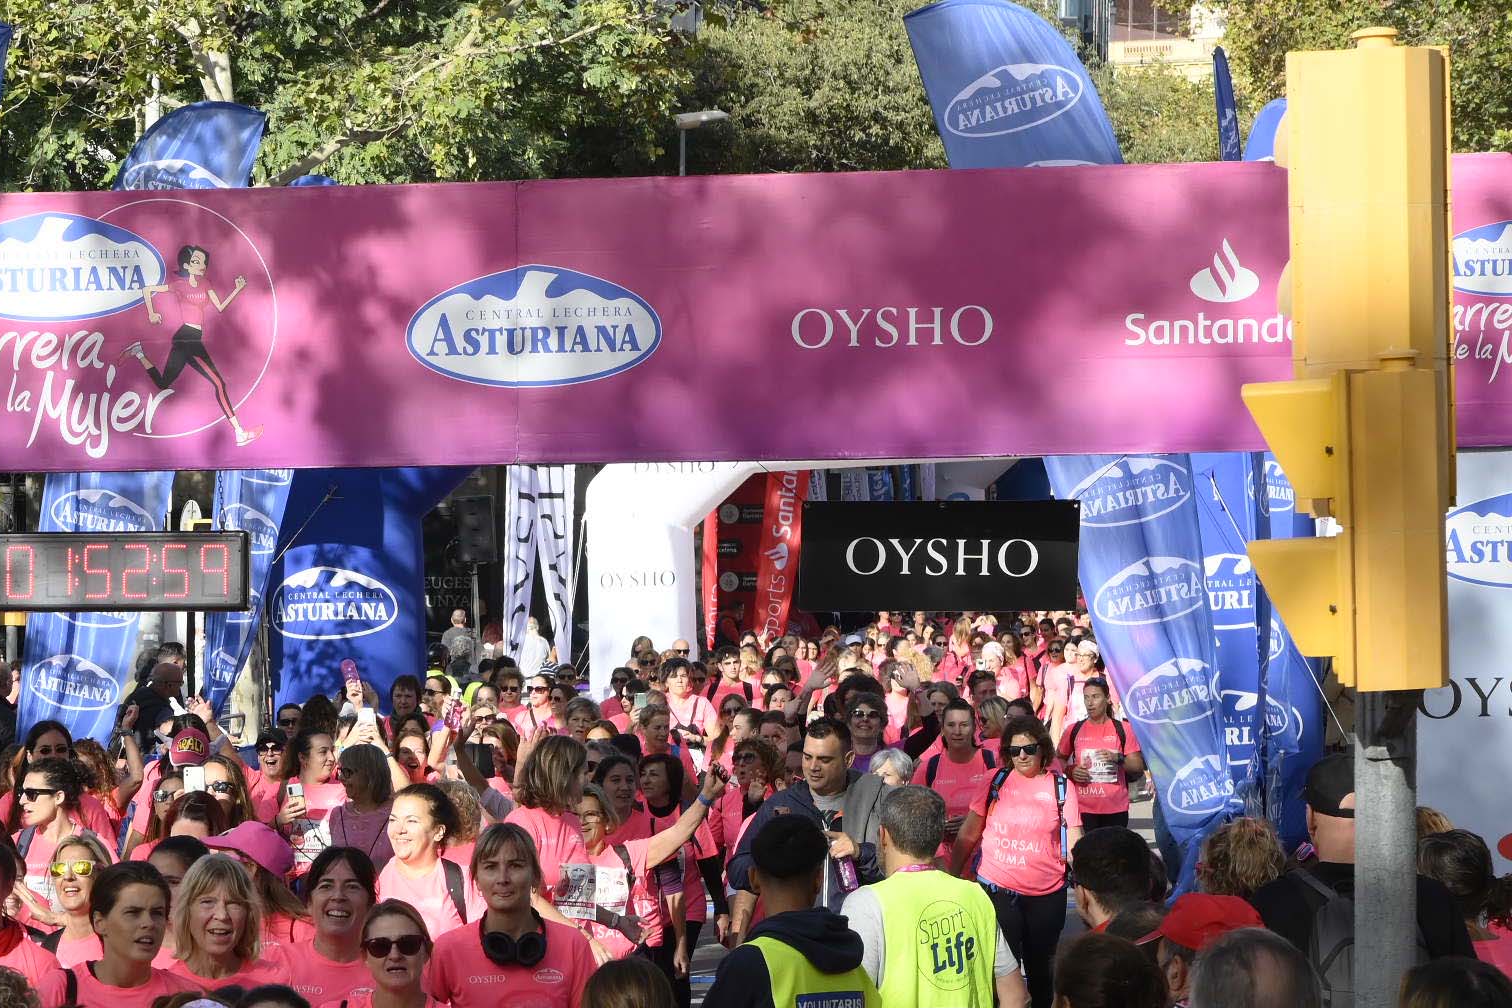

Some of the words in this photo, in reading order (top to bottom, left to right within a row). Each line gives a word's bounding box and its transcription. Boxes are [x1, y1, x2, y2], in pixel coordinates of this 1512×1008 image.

[68, 249, 141, 260] LECHERA
[465, 308, 544, 321] CENTRAL
[552, 306, 633, 319] LECHERA
[791, 305, 994, 349] OYSHO
[1124, 311, 1293, 346] Santand
[426, 312, 642, 357] ASTURIANA
[1475, 332, 1493, 360] la
[6, 372, 31, 413] la
[26, 365, 176, 458] Mujer
[846, 536, 1039, 577] OYSHO
[600, 569, 676, 590] OYSHO
[275, 596, 389, 624] ASTURIANA
[993, 851, 1027, 866] SUMA
[919, 908, 966, 945] Sport
[931, 931, 976, 975] Life
[469, 974, 506, 984] OYSHO
